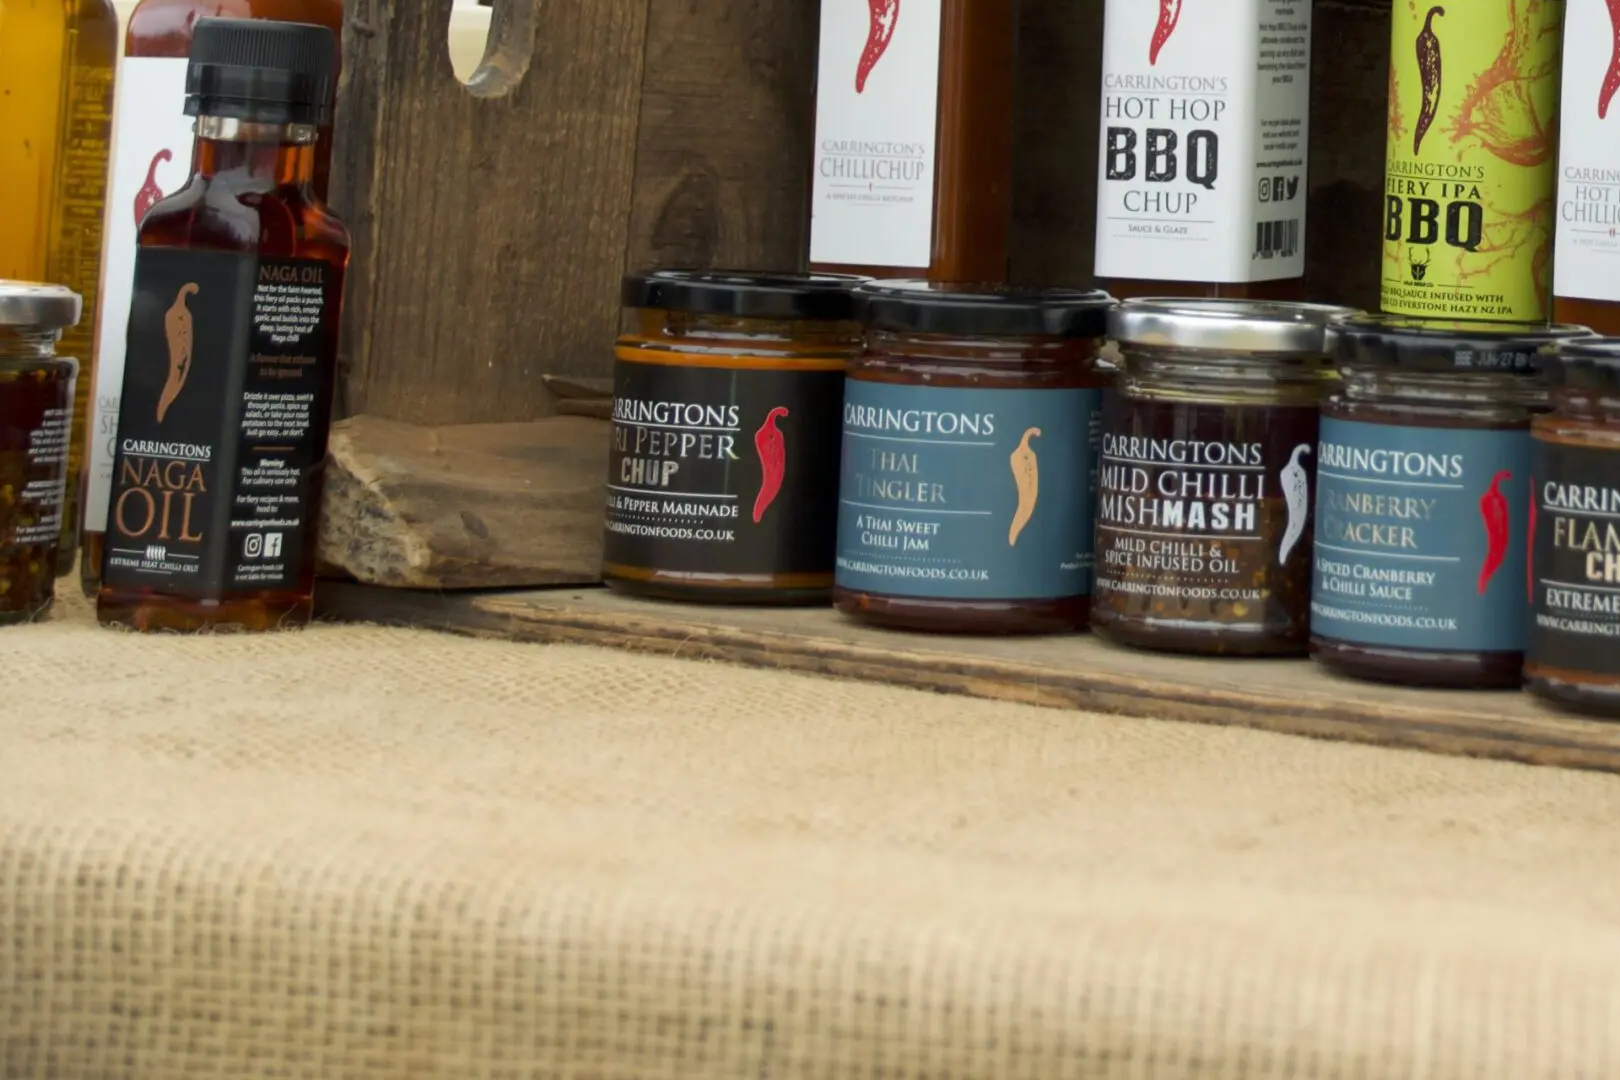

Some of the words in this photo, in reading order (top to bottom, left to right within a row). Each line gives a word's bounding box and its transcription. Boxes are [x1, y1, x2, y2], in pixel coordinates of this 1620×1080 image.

[1103, 73, 1228, 92] CARRINGTON'S
[1105, 96, 1160, 119] HOT
[1169, 98, 1226, 121] HOP
[822, 139, 925, 155] CARRINGTON'S
[1105, 126, 1219, 190] BBQ
[820, 156, 925, 181] CHILLICHUP
[1123, 190, 1197, 214] CHUP
[1441, 184, 1482, 199] IPA
[1575, 185, 1612, 202] HOT
[1385, 194, 1484, 252] BBQ
[259, 264, 298, 282] NAGA
[301, 266, 324, 283] OIL
[1430, 292, 1473, 302] INFUSED
[1475, 294, 1504, 303] WITH
[1450, 304, 1478, 313] HAZY
[844, 403, 995, 435] CARRINGTONS
[123, 438, 212, 458] CARRINGTONS
[634, 426, 741, 460] PEPPER
[1102, 432, 1263, 464] CARRINGTONS
[621, 456, 680, 486] CHUP
[868, 448, 919, 474] THAI
[120, 456, 208, 492] NAGA
[1101, 465, 1149, 493] MILD
[1158, 471, 1265, 500] CHILLI
[115, 486, 203, 542] OIL
[623, 495, 660, 513] PEPPER
[662, 500, 741, 518] MARINADE
[1101, 493, 1255, 530] MISHMASH
[857, 515, 864, 527] A
[864, 516, 892, 531] THAI
[896, 519, 940, 535] SWEET
[861, 532, 899, 548] CHILLI
[902, 536, 930, 551] JAM
[1114, 537, 1146, 553] MILD
[1150, 540, 1204, 557] CHILLI
[1209, 544, 1222, 558] &
[1105, 549, 1133, 566] SPICE
[1136, 554, 1204, 573] INFUSED
[1209, 559, 1240, 574] OIL
[1320, 558, 1350, 577] SPICED
[1353, 564, 1436, 585] CRANBERRY
[1329, 577, 1366, 596] CHILLI
[1369, 582, 1413, 600] SAUCE
